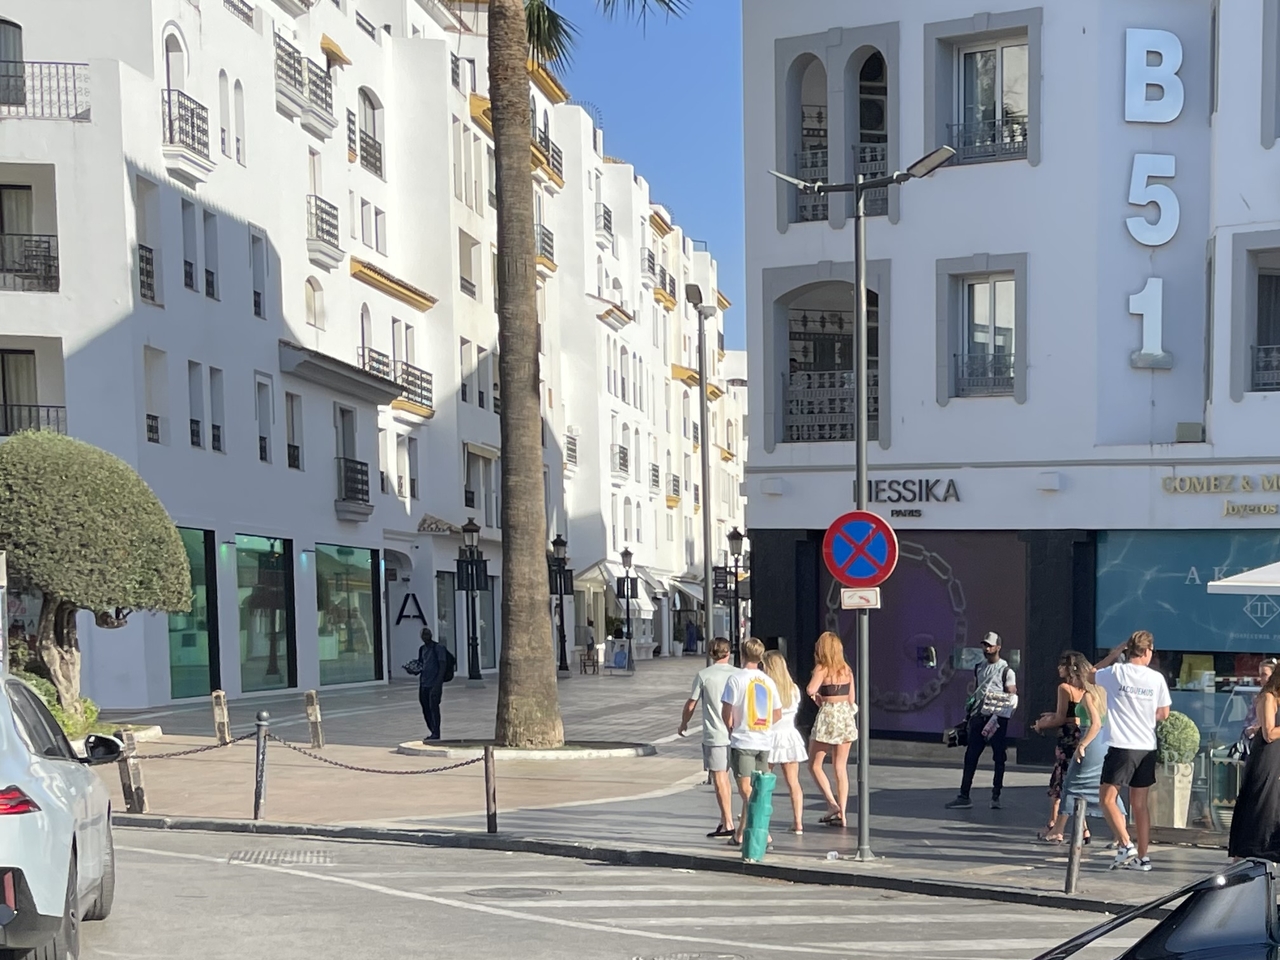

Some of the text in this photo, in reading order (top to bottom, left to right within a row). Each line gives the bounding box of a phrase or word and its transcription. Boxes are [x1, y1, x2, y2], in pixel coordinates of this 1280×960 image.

[1124, 27, 1185, 370] B51
[1161, 475, 1236, 494] GOMEZ
[1240, 475, 1253, 493] &
[891, 509, 922, 518] PARIS
[1222, 500, 1280, 518] Joyeros
[395, 592, 428, 626] A
[1118, 684, 1154, 697] JACQUEMUS
[1162, 749, 1207, 779] B51
